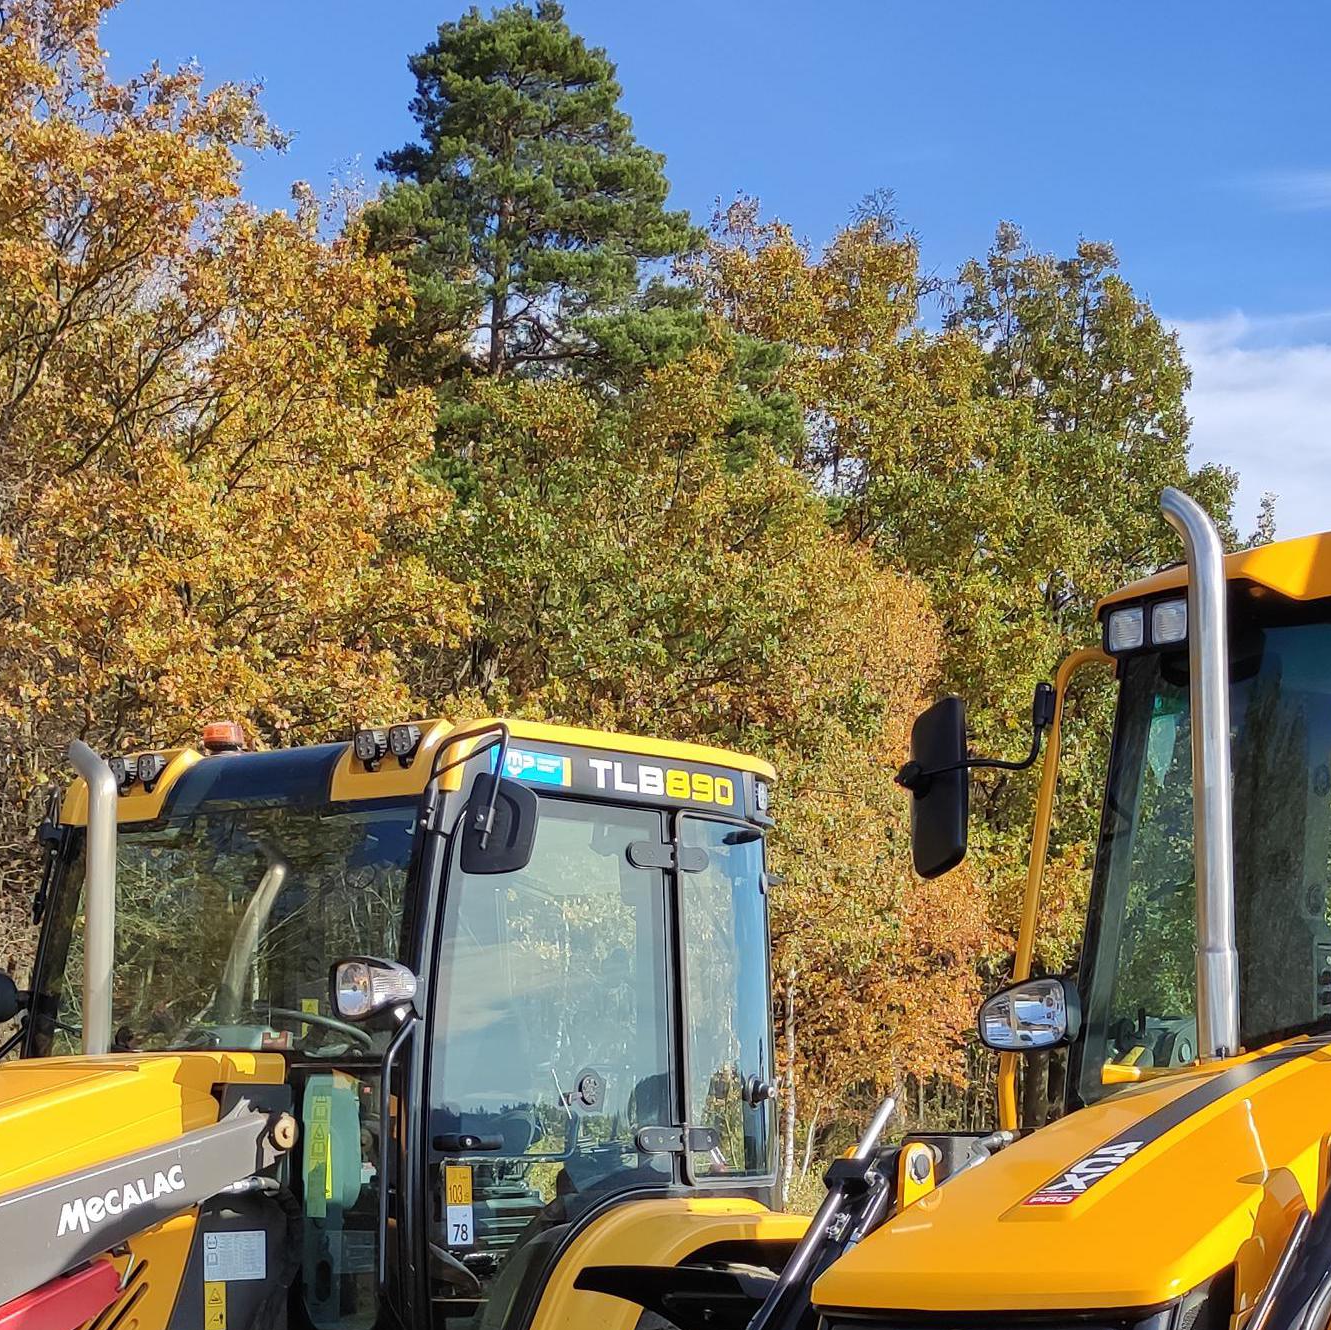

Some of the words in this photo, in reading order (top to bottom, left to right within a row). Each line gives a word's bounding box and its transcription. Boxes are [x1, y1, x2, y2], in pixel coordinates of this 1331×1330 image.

[588, 757, 734, 806] TLB890
[1043, 1140, 1145, 1191] 4CX
[449, 1184, 463, 1203] 103
[1028, 1195, 1074, 1204] PRO
[452, 1223, 469, 1242] 78
